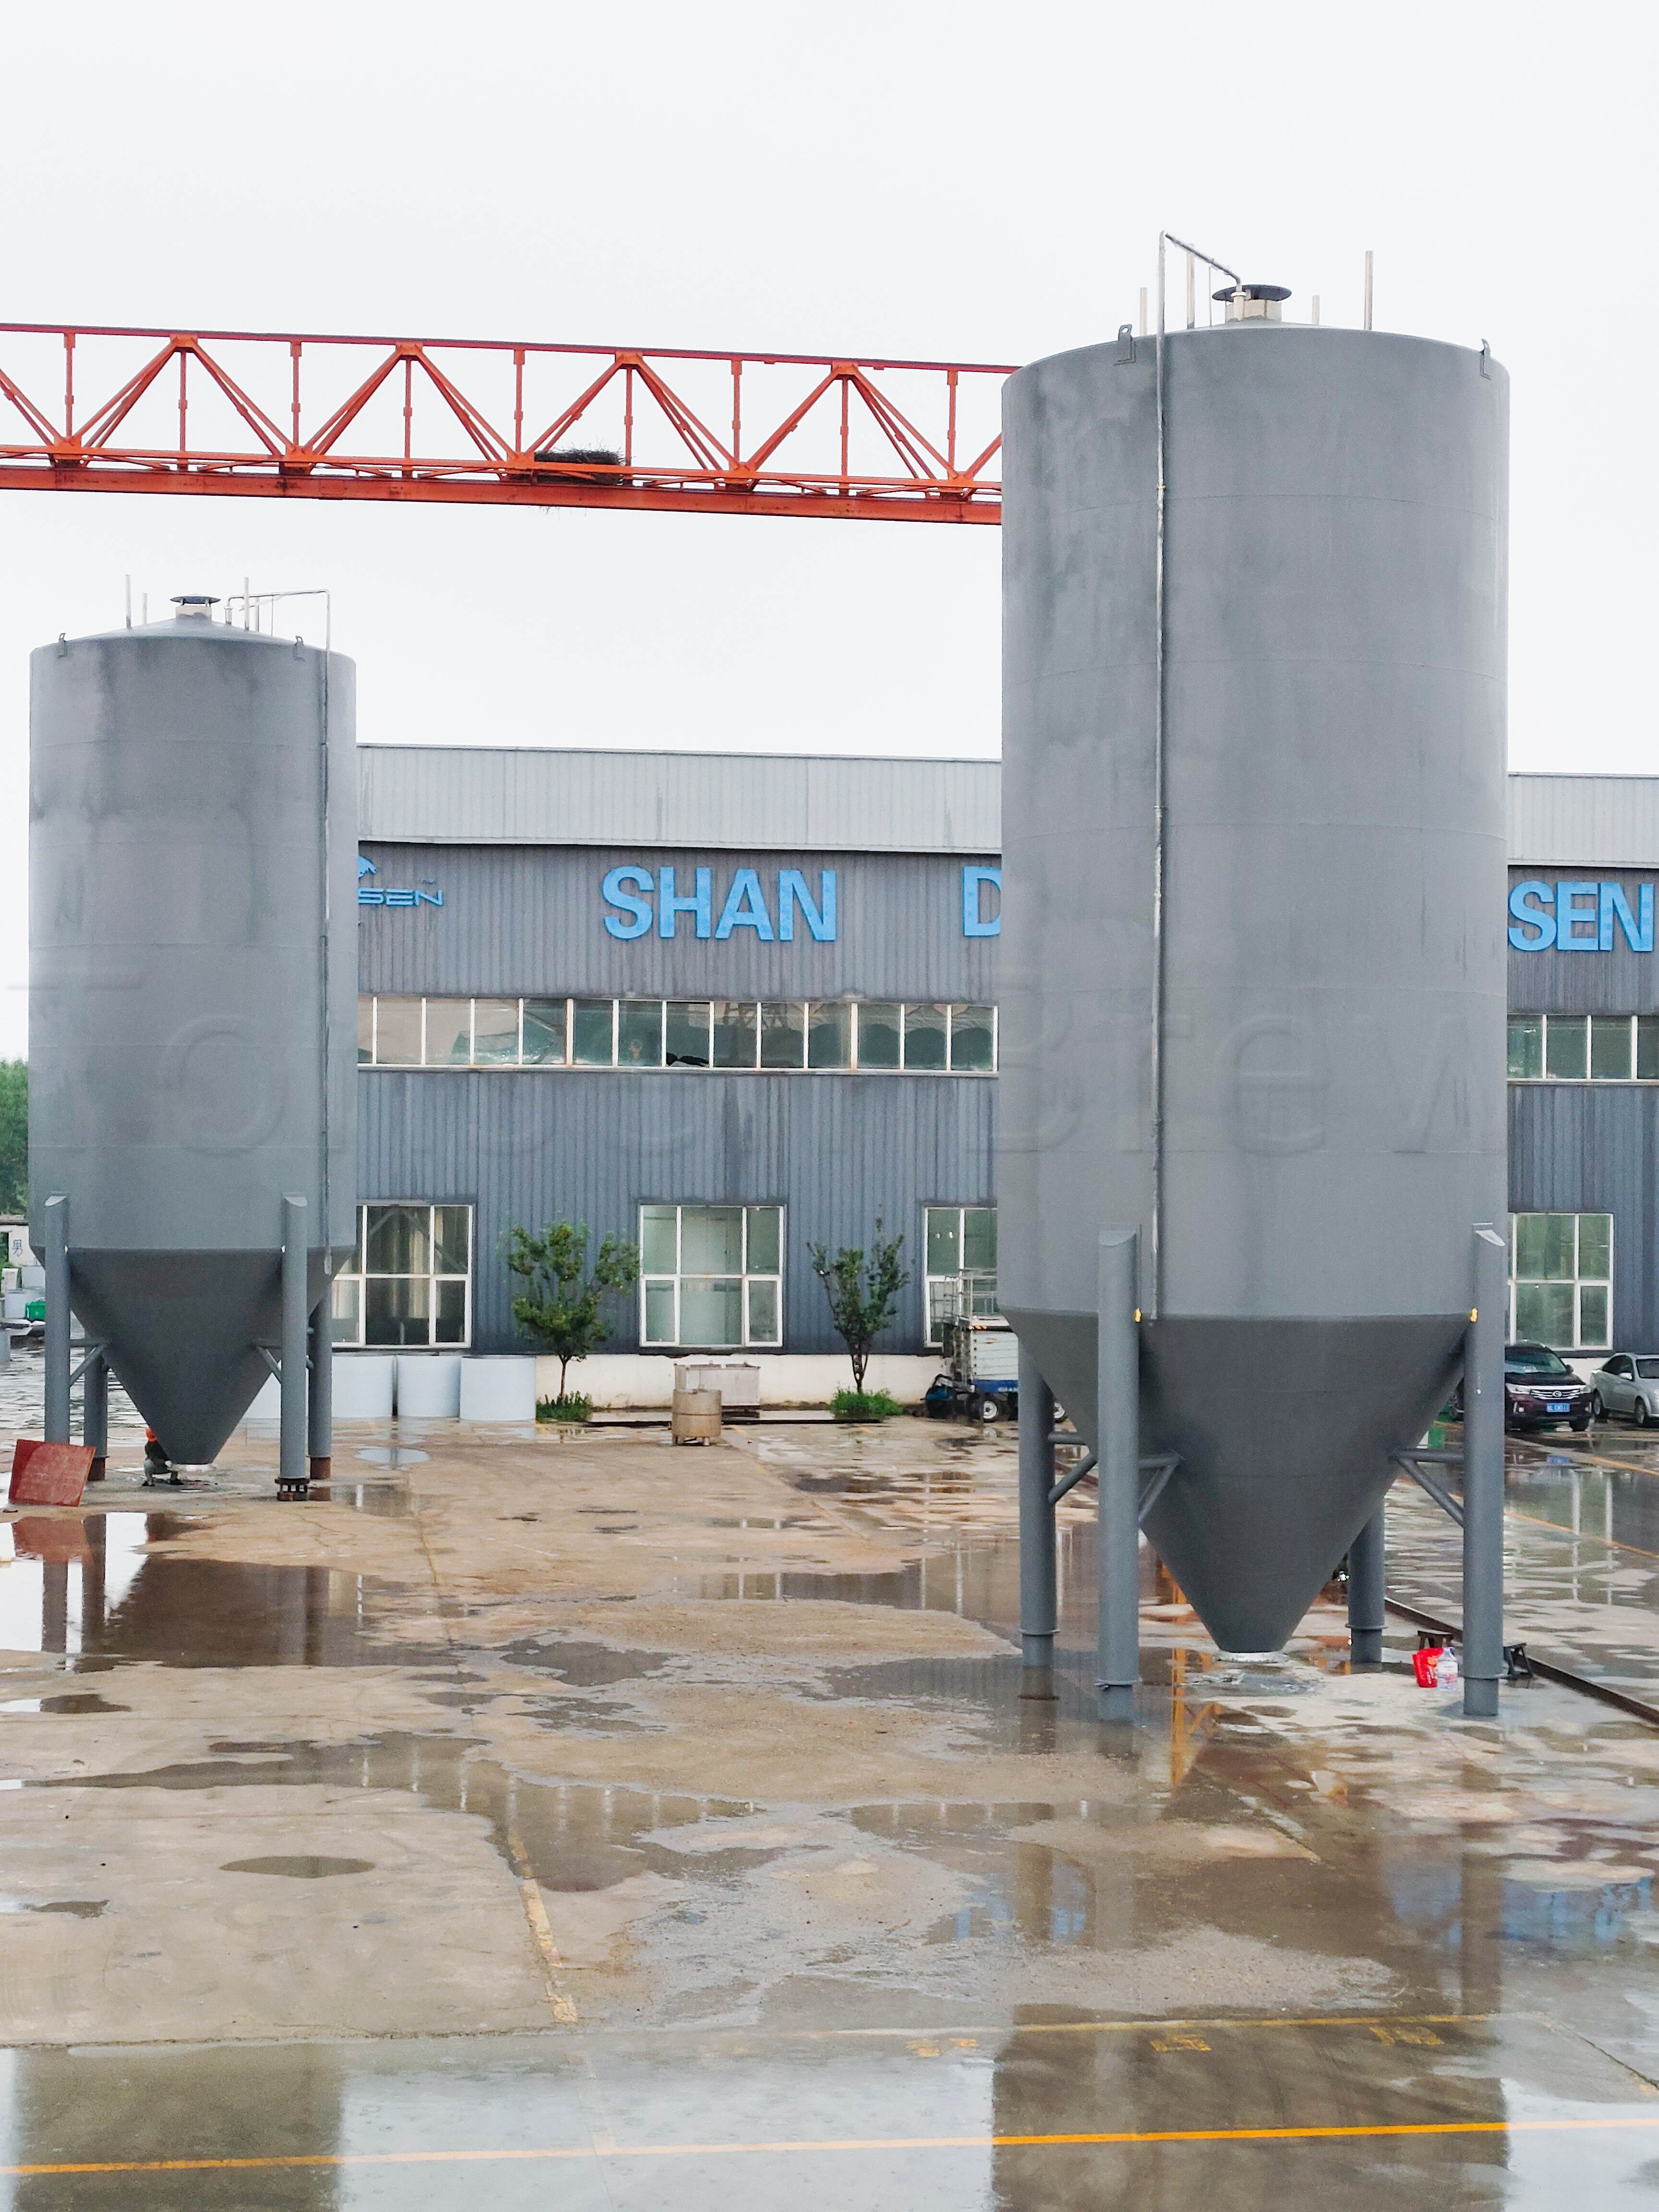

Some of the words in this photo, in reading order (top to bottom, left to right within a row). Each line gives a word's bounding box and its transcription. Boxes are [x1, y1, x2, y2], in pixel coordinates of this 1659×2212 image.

[601, 866, 837, 942] SHAN
[1508, 880, 1654, 952] SEN
[12, 1239, 23, 1257] 男
